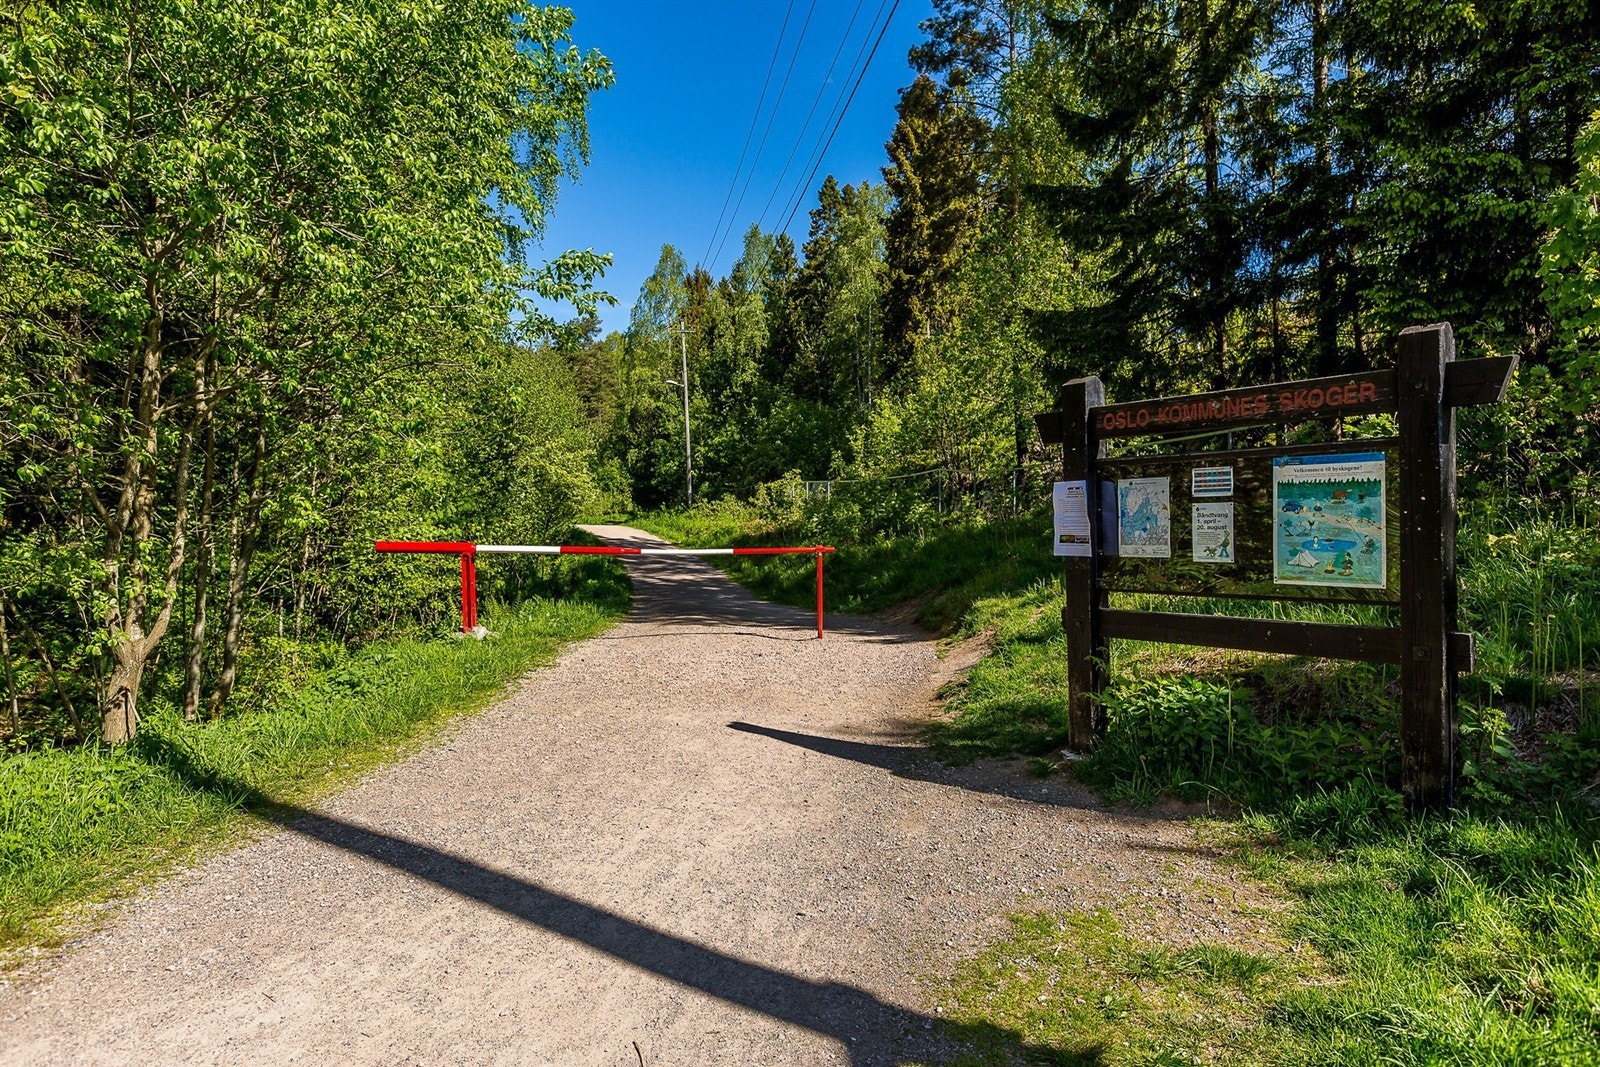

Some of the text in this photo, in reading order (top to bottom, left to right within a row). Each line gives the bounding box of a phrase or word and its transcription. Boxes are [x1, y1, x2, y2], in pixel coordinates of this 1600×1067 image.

[1103, 382, 1376, 430] OSLO KOMMUNES SKOGER
